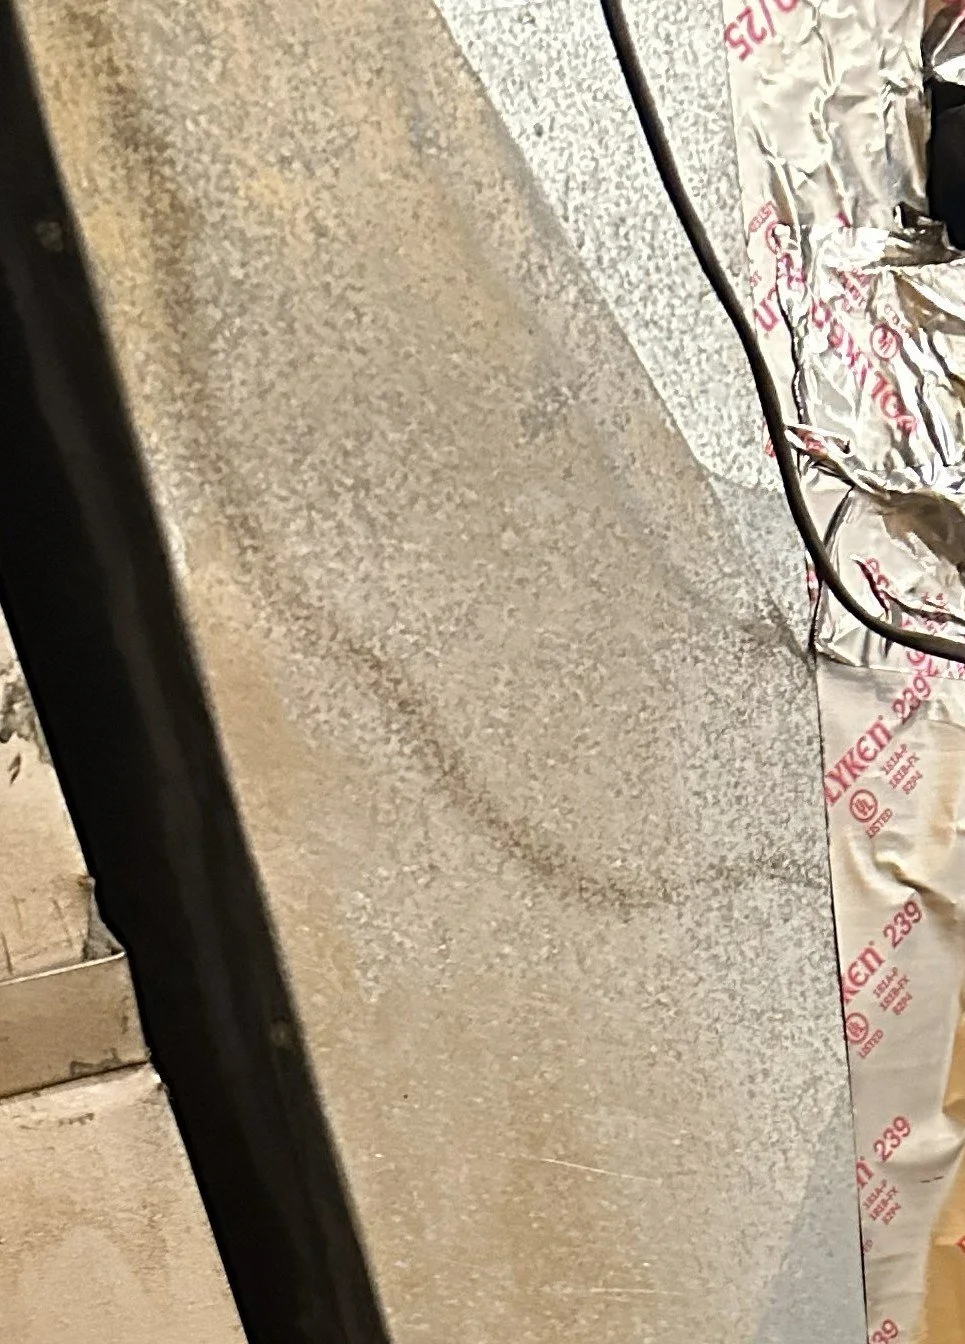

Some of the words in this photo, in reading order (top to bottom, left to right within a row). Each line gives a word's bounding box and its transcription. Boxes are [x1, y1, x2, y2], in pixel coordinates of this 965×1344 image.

[889, 675, 933, 725] 239
[883, 899, 924, 949] 239
[873, 1114, 912, 1163] 239
